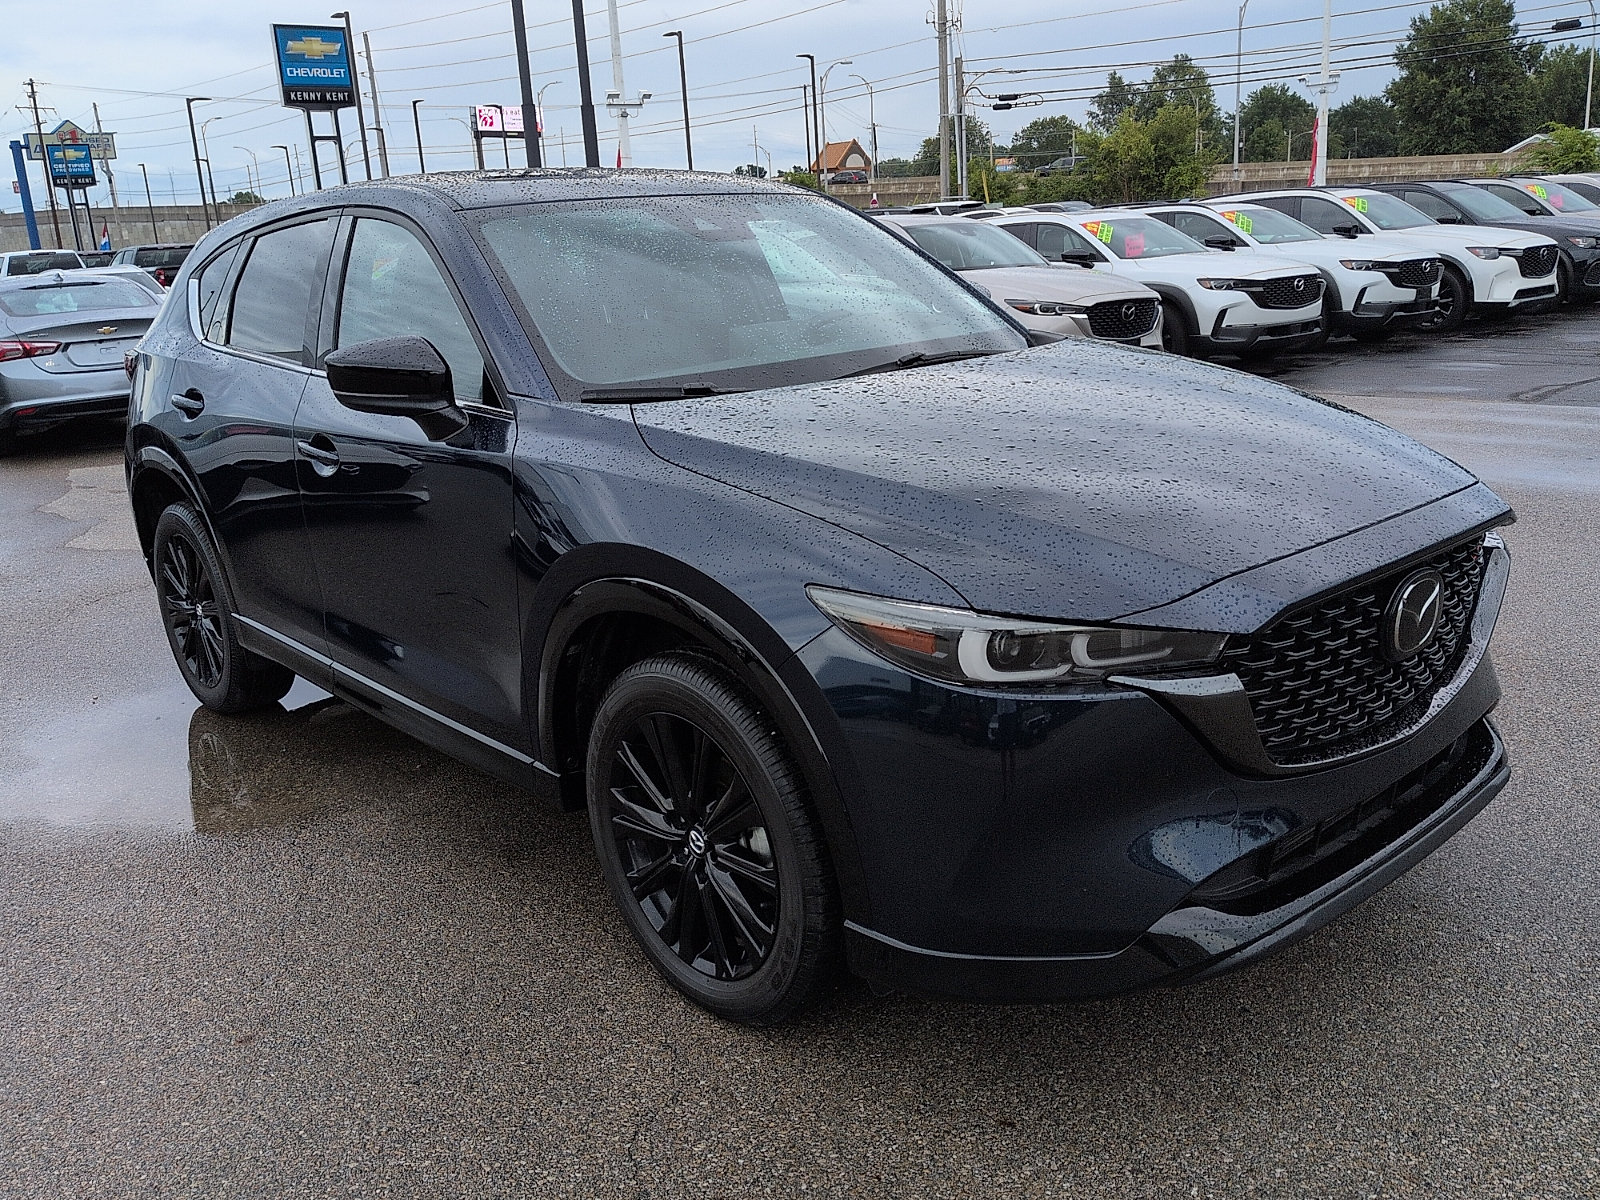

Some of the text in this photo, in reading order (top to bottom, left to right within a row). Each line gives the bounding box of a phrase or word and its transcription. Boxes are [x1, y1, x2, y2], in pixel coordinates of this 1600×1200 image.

[286, 67, 346, 78] CHEVROLET
[290, 91, 349, 101] KENNY KENT
